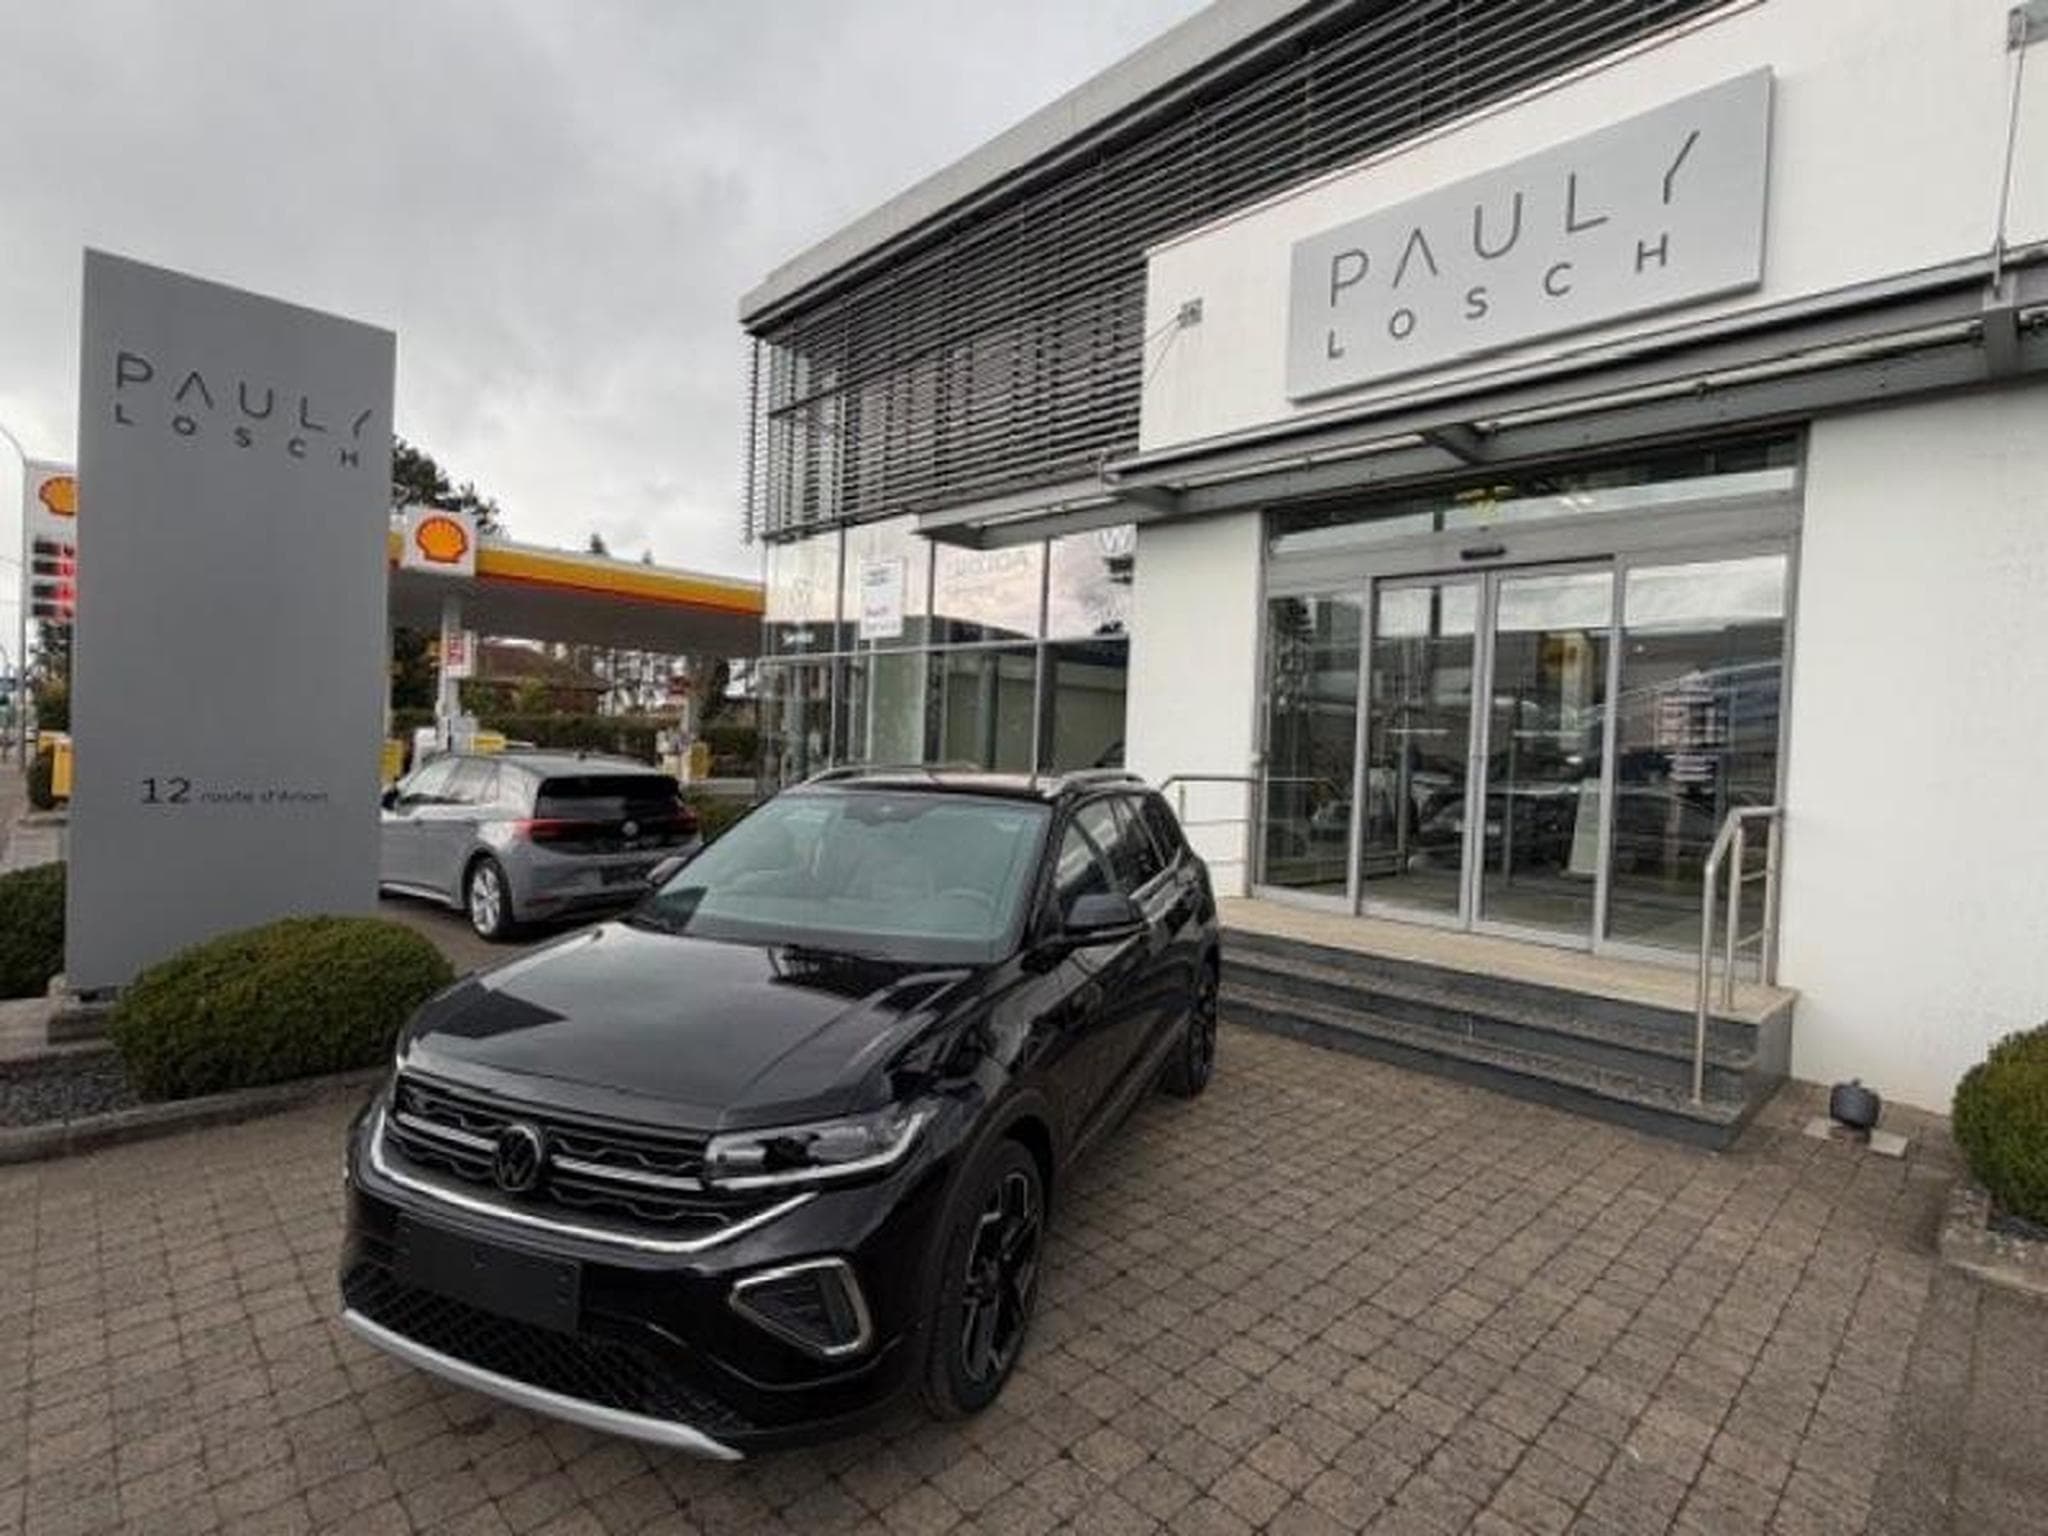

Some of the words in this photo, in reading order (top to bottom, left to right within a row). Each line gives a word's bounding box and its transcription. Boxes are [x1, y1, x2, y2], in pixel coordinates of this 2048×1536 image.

[1330, 131, 1699, 307] PAULY
[1328, 233, 1669, 359] LOSCH
[115, 404, 359, 468] LOSCH
[116, 351, 372, 437] PAULY
[141, 776, 191, 803] 12
